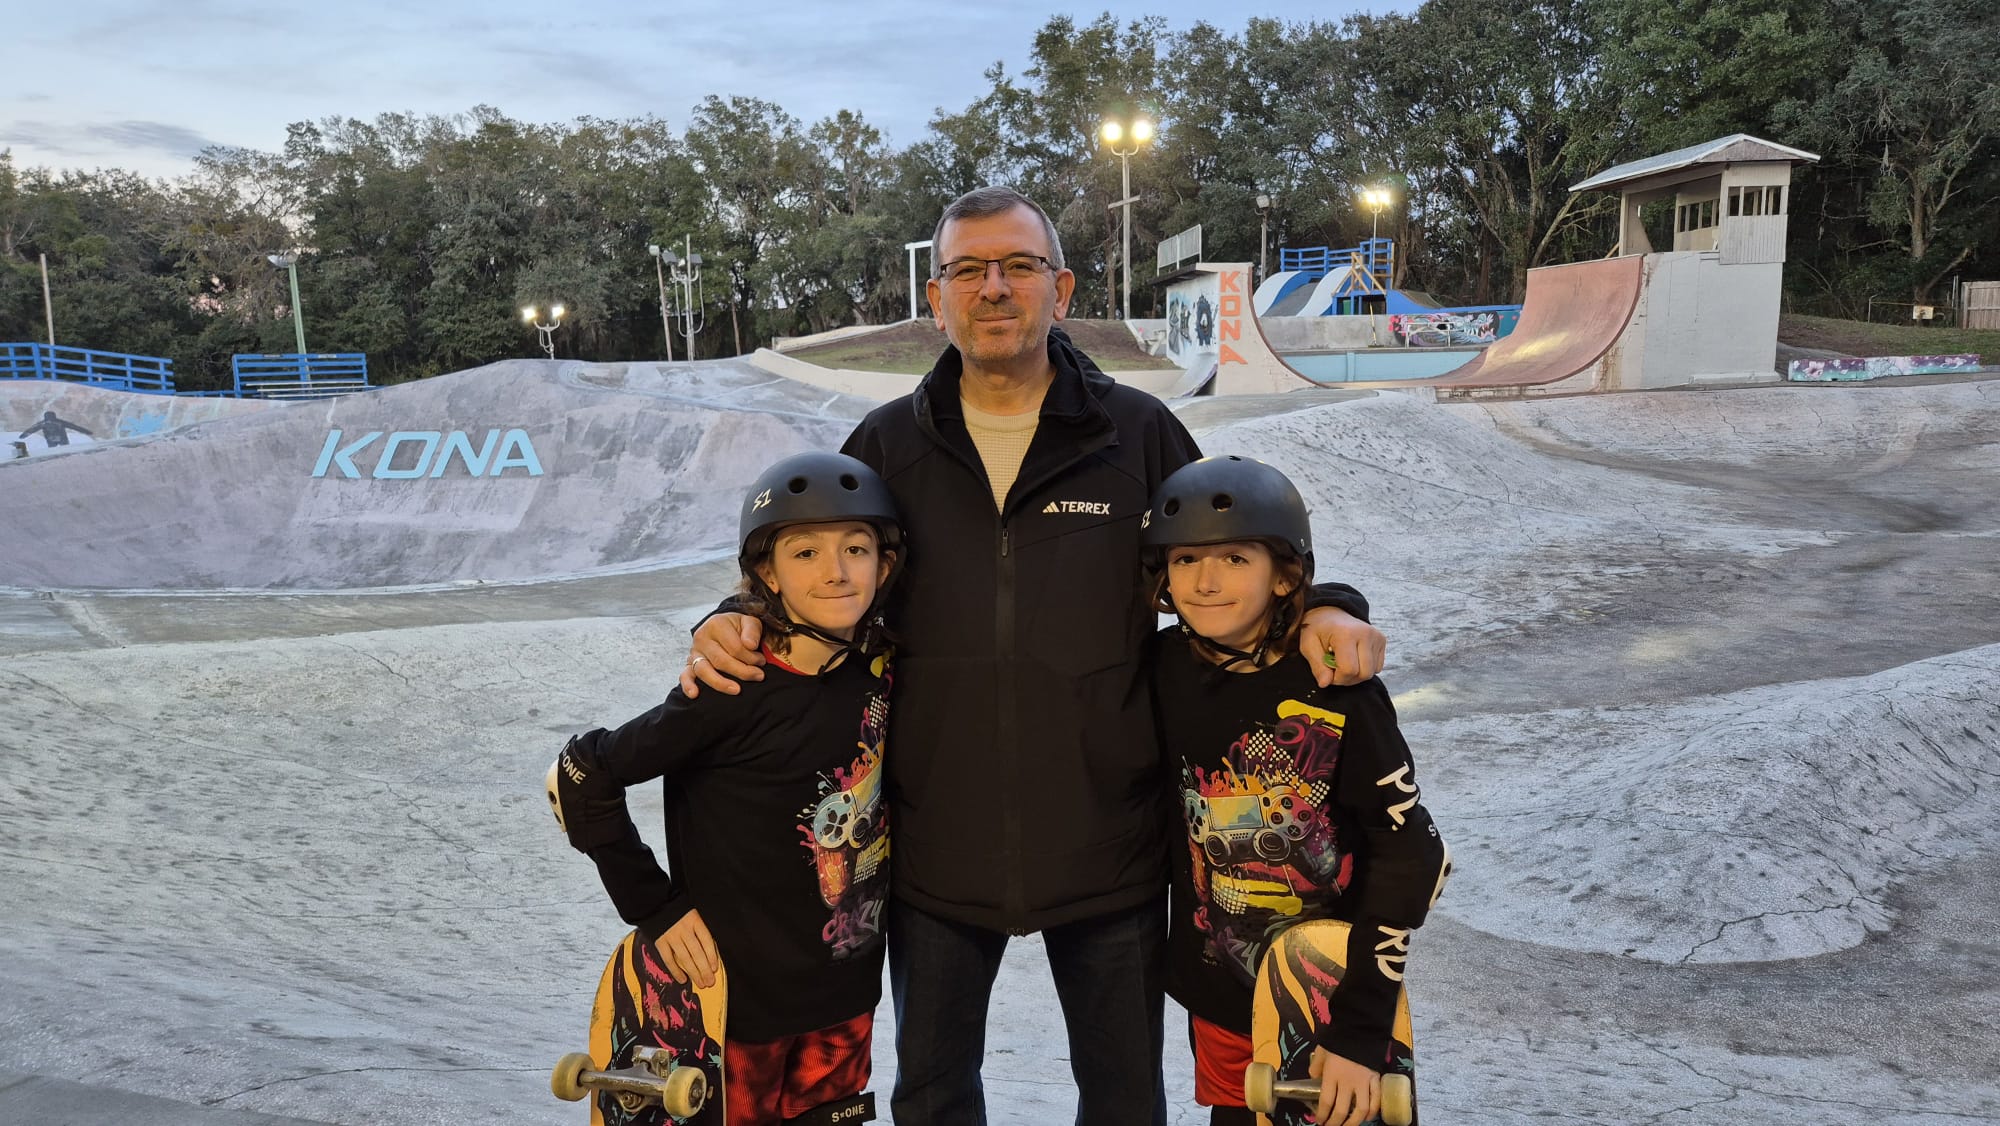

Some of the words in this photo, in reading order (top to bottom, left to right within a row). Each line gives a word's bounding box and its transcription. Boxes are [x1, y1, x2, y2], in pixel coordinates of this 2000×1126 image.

[1220, 270, 1248, 366] KONA
[311, 429, 545, 480] KONA
[751, 488, 772, 515] S1
[1060, 500, 1111, 516] TERREX
[1376, 761, 1420, 832] PL
[1374, 925, 1411, 982] RD
